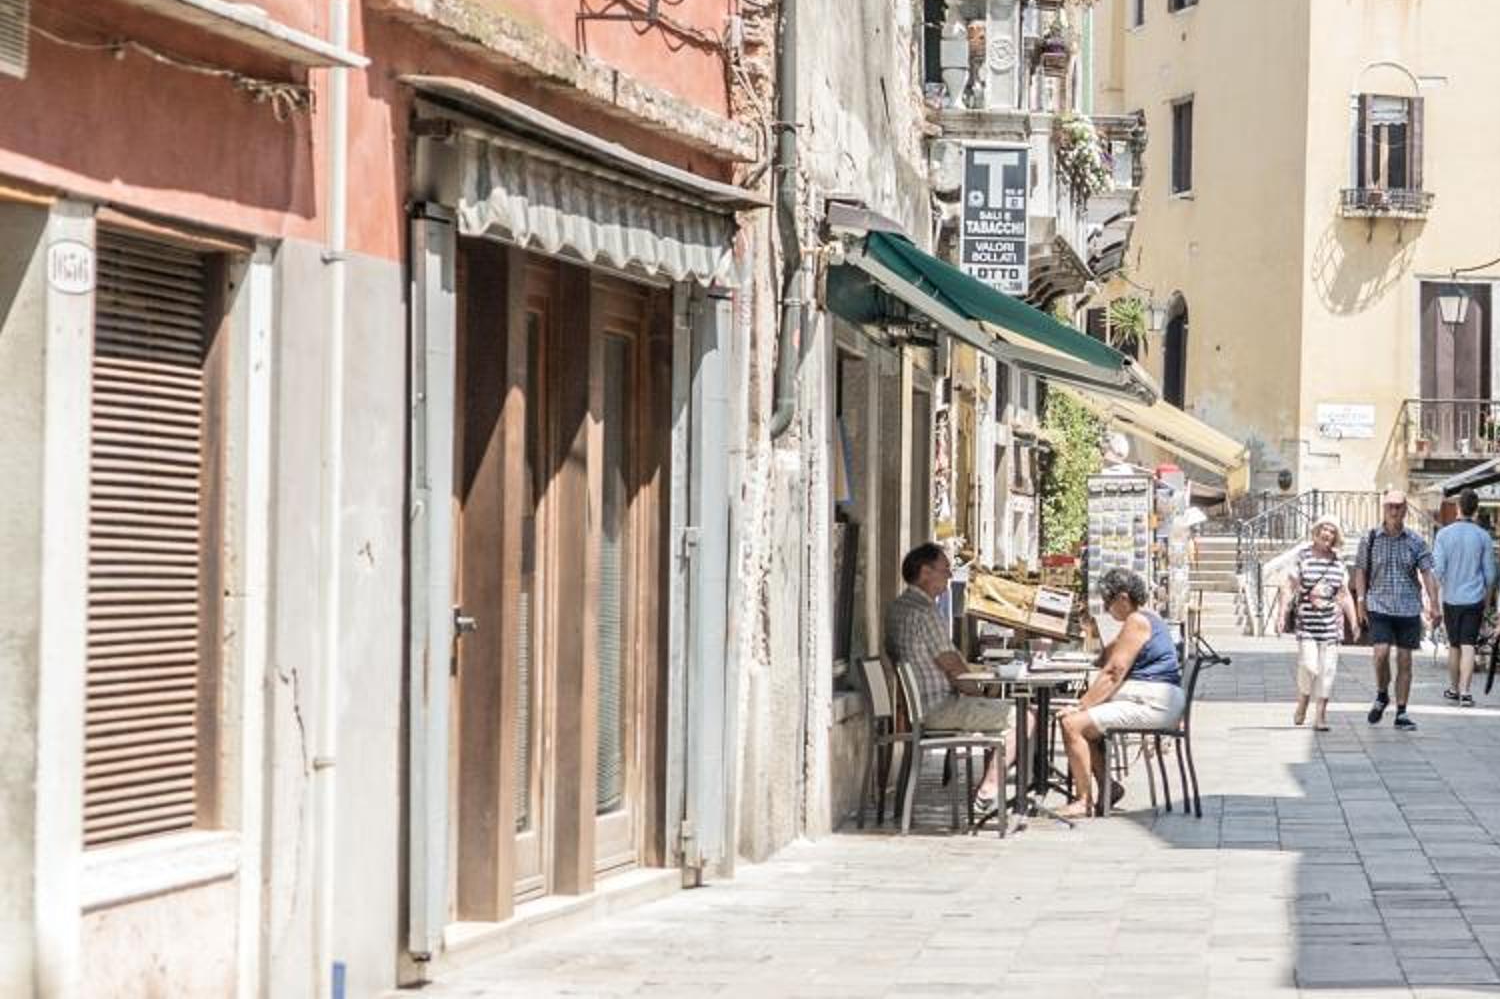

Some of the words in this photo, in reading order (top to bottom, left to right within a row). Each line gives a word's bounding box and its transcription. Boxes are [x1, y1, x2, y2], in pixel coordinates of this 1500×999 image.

[979, 210, 1002, 221] SALI
[965, 220, 1025, 235] TABACCHI
[975, 241, 1014, 252] VALORI
[971, 252, 1017, 263] BOLLATI
